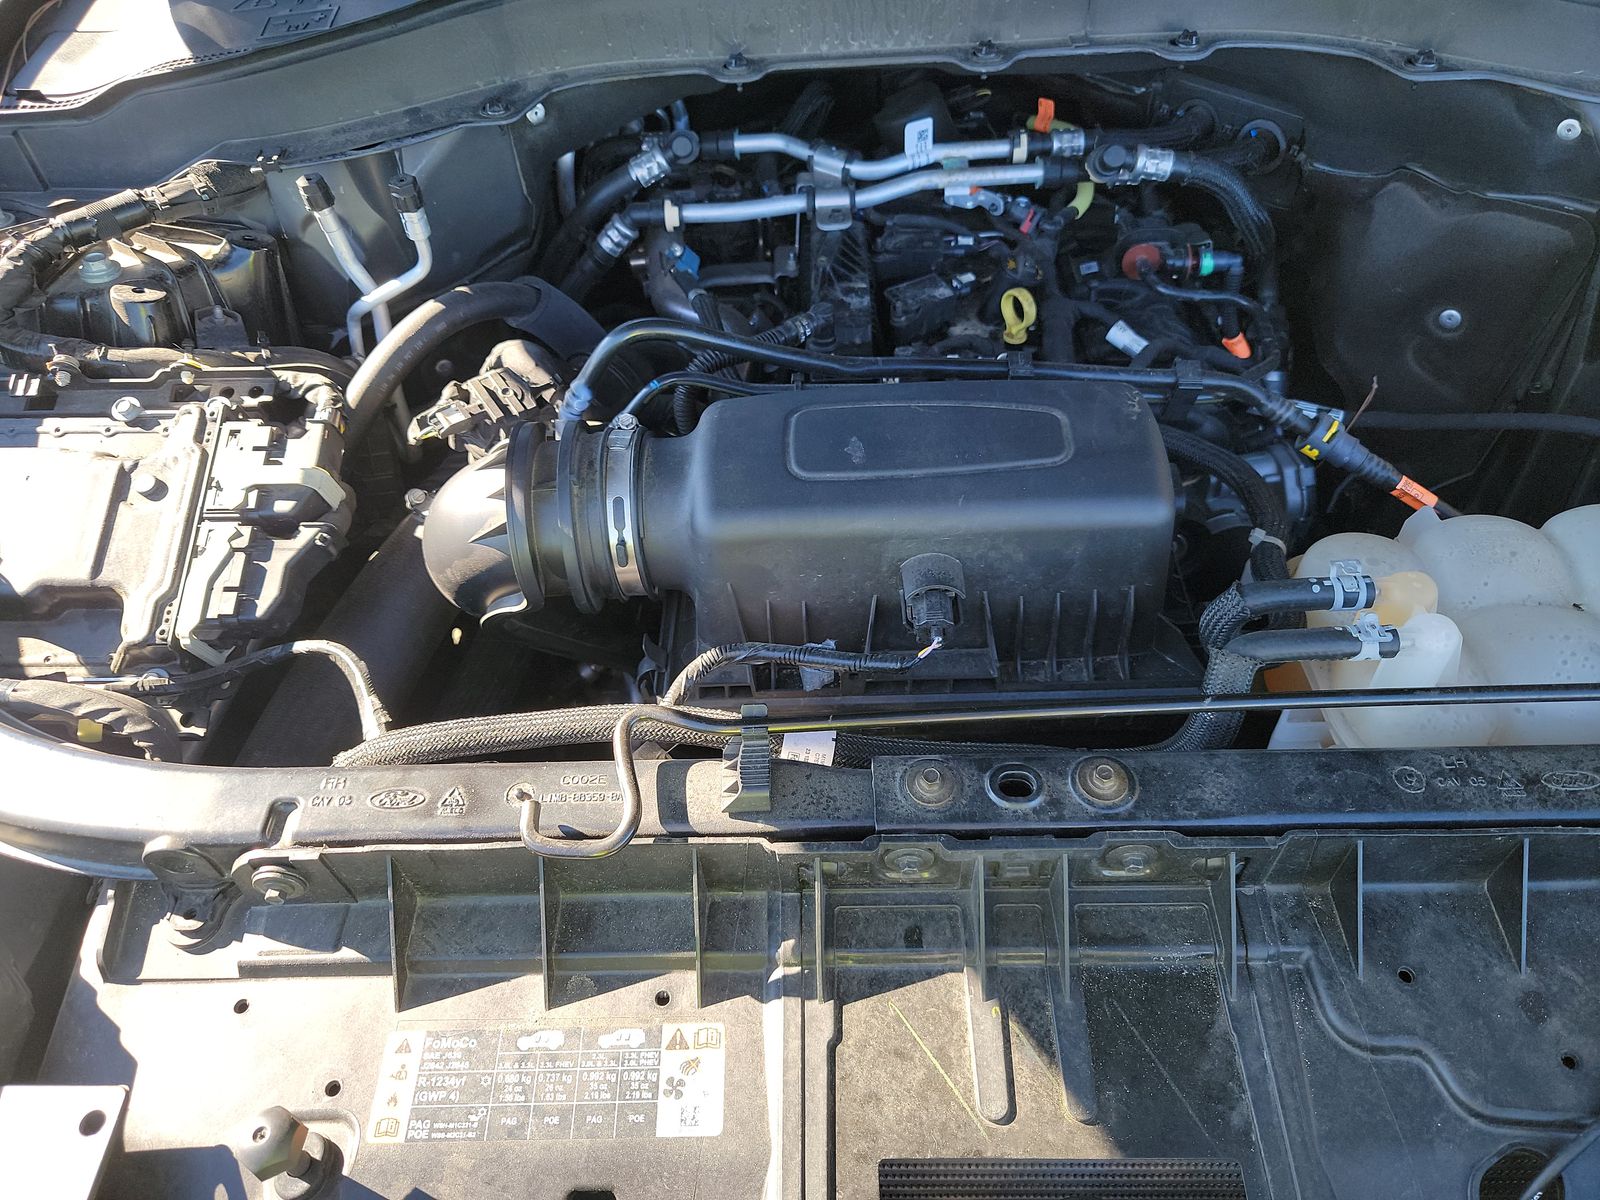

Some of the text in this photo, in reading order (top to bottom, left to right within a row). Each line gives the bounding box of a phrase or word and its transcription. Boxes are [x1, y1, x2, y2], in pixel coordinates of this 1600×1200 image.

[424, 1036, 477, 1049] FoMoCo
[521, 1073, 532, 1085] kg
[562, 1072, 572, 1084] kg
[606, 1072, 616, 1082] kg
[647, 1071, 658, 1082] kg
[417, 1075, 467, 1089] R-1234yf
[501, 1117, 518, 1125] PAG
[543, 1116, 560, 1125] POE
[586, 1115, 603, 1124] PAG
[629, 1114, 645, 1123] POE
[409, 1120, 430, 1129] PAG
[407, 1130, 429, 1139] POE
